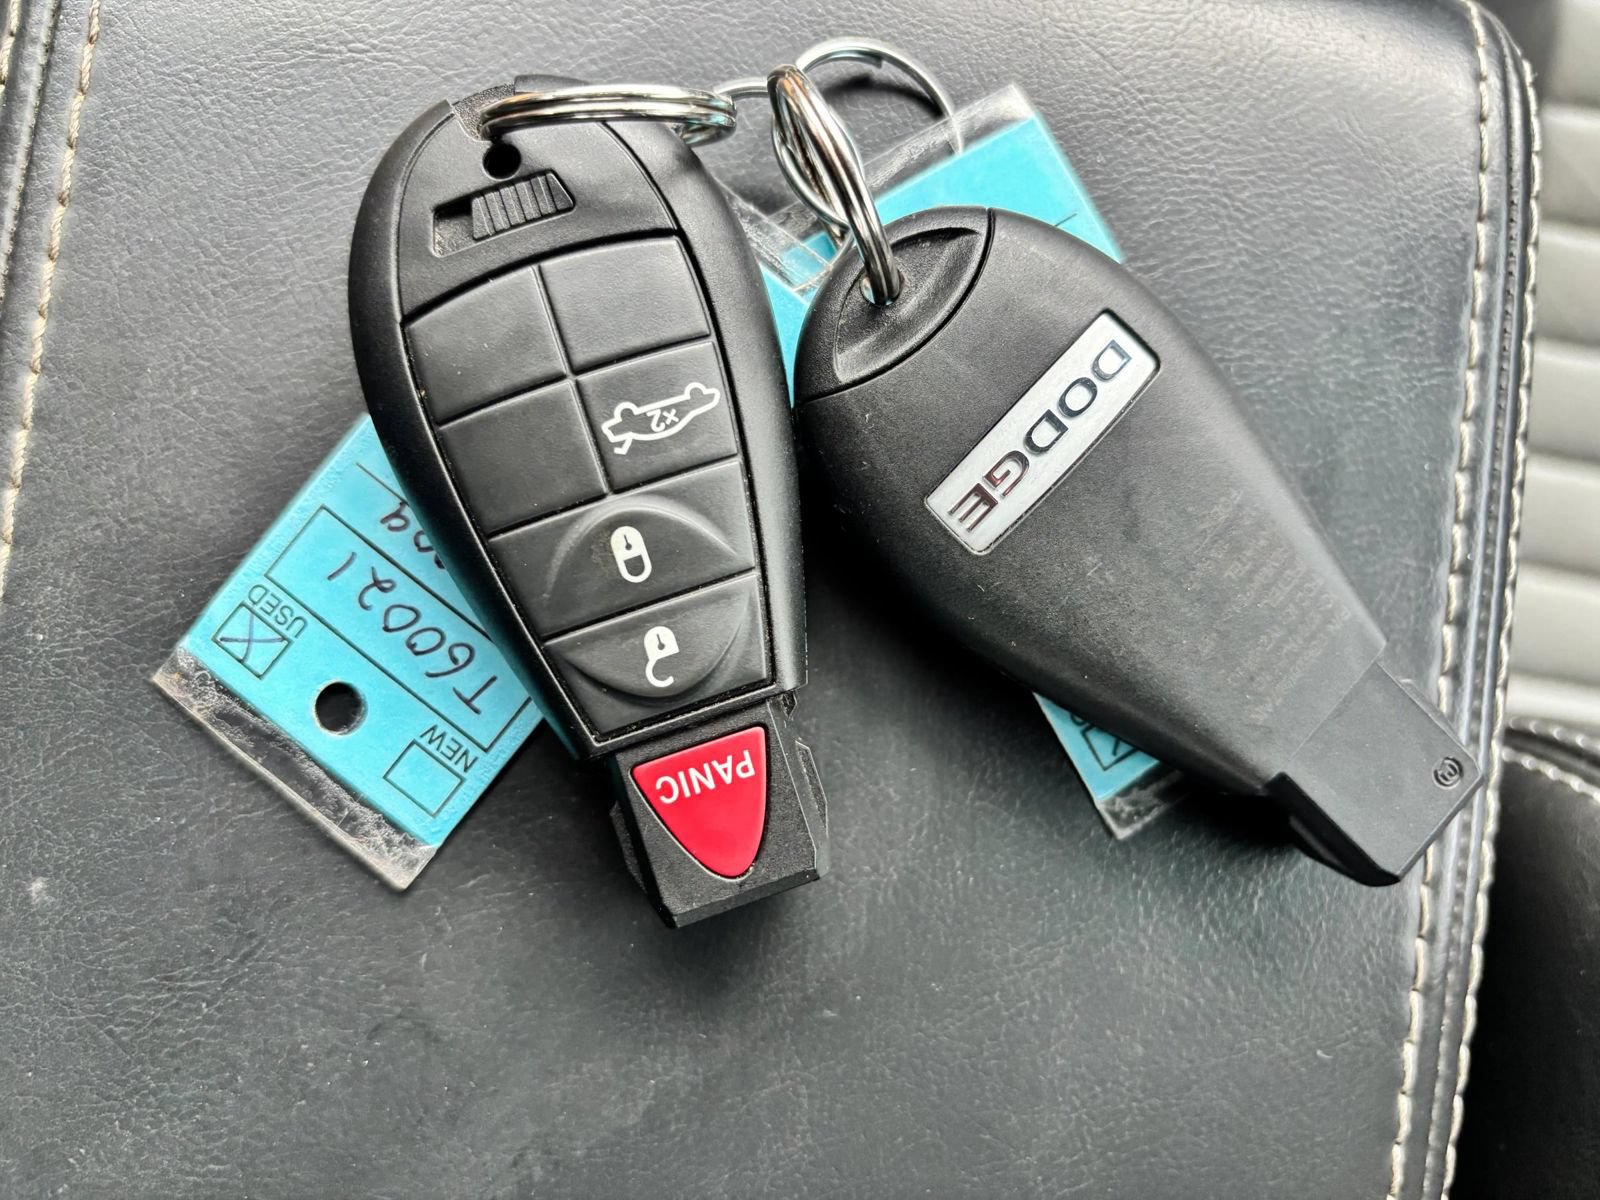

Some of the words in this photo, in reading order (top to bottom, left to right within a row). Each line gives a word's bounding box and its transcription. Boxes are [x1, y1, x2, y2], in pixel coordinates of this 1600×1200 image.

[947, 338, 1133, 533] DODGE
[247, 582, 308, 638] USED
[327, 551, 497, 716] T60021
[419, 724, 479, 773] NEW
[655, 749, 756, 805] PANIC
